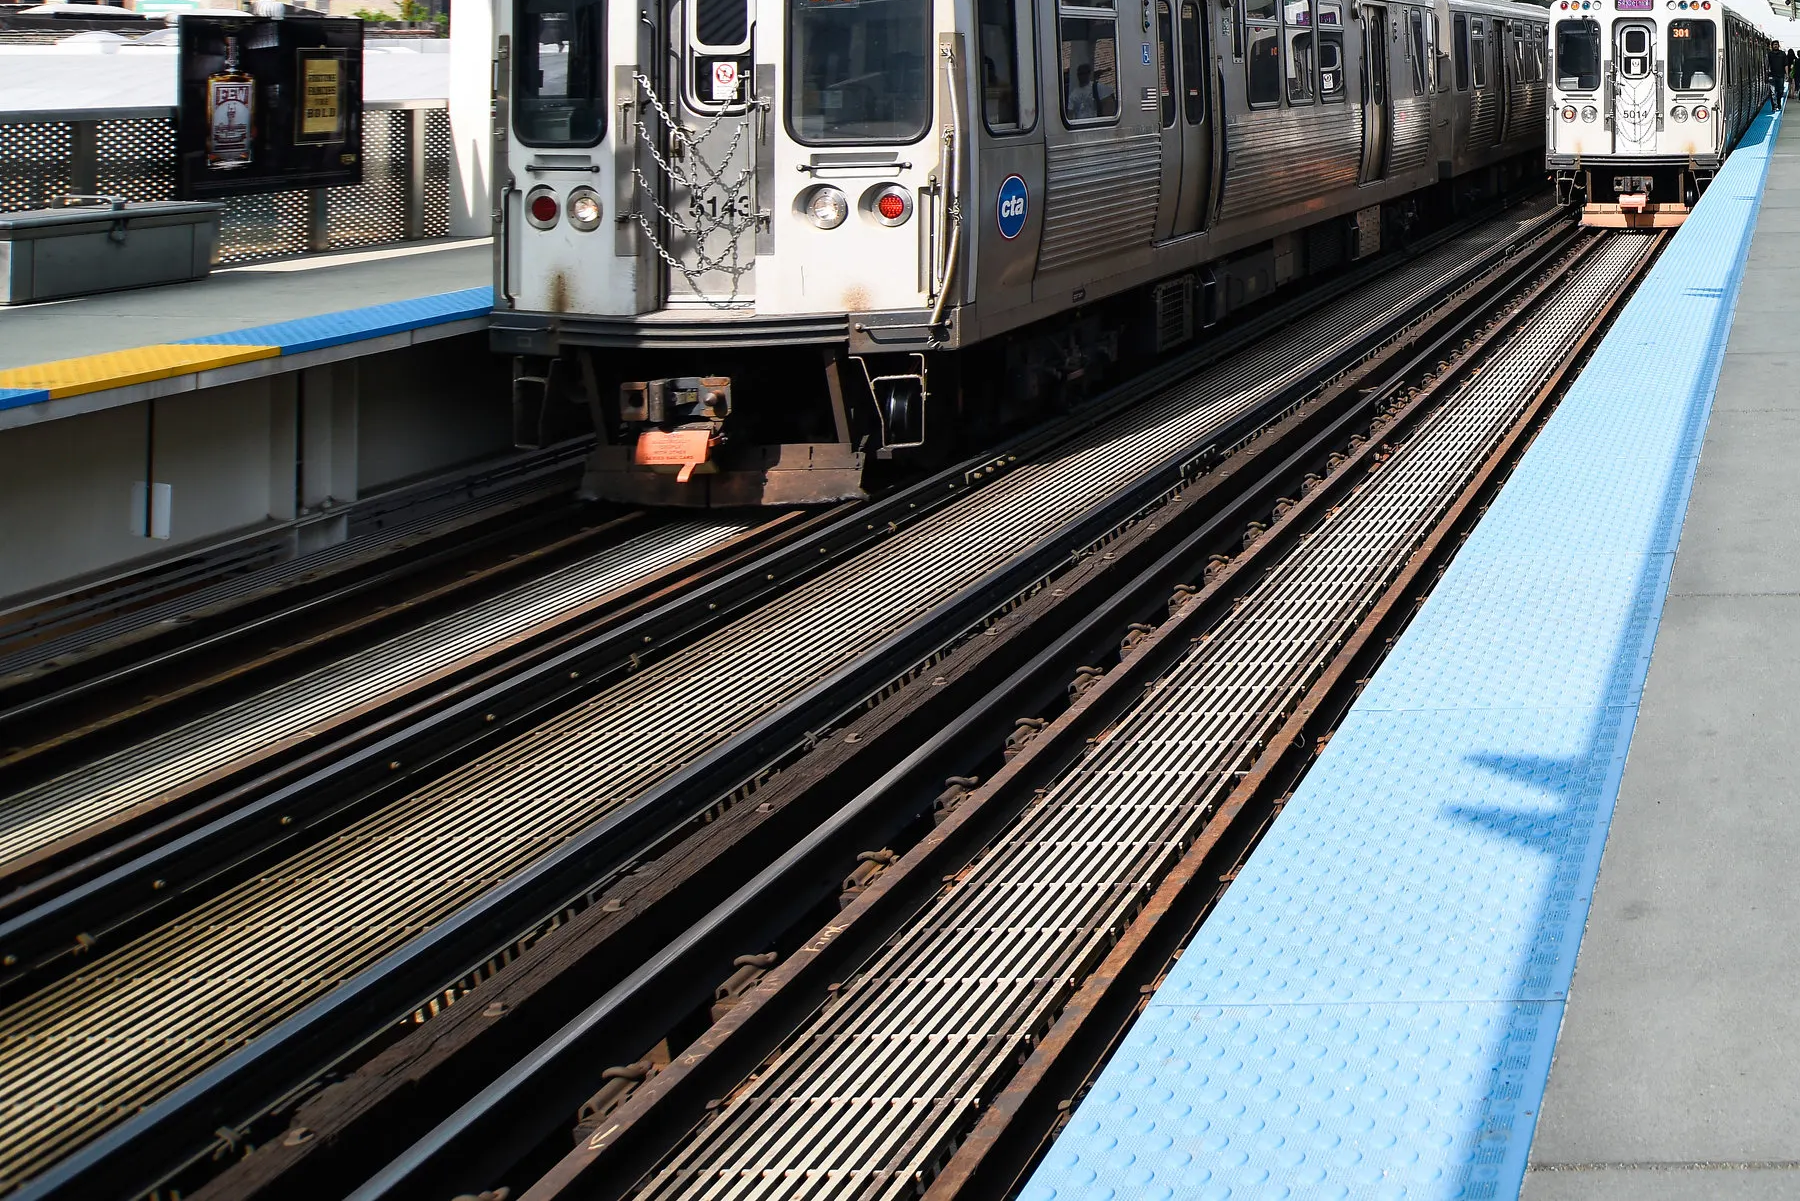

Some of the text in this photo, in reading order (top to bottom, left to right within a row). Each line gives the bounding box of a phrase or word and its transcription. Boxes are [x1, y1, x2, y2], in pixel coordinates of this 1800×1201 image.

[1673, 28, 1690, 38] 301
[218, 87, 248, 102] FEW
[307, 107, 336, 118] BOLD
[1623, 110, 1648, 119] 5014
[688, 195, 750, 218] 5143
[1002, 195, 1024, 218] cta
